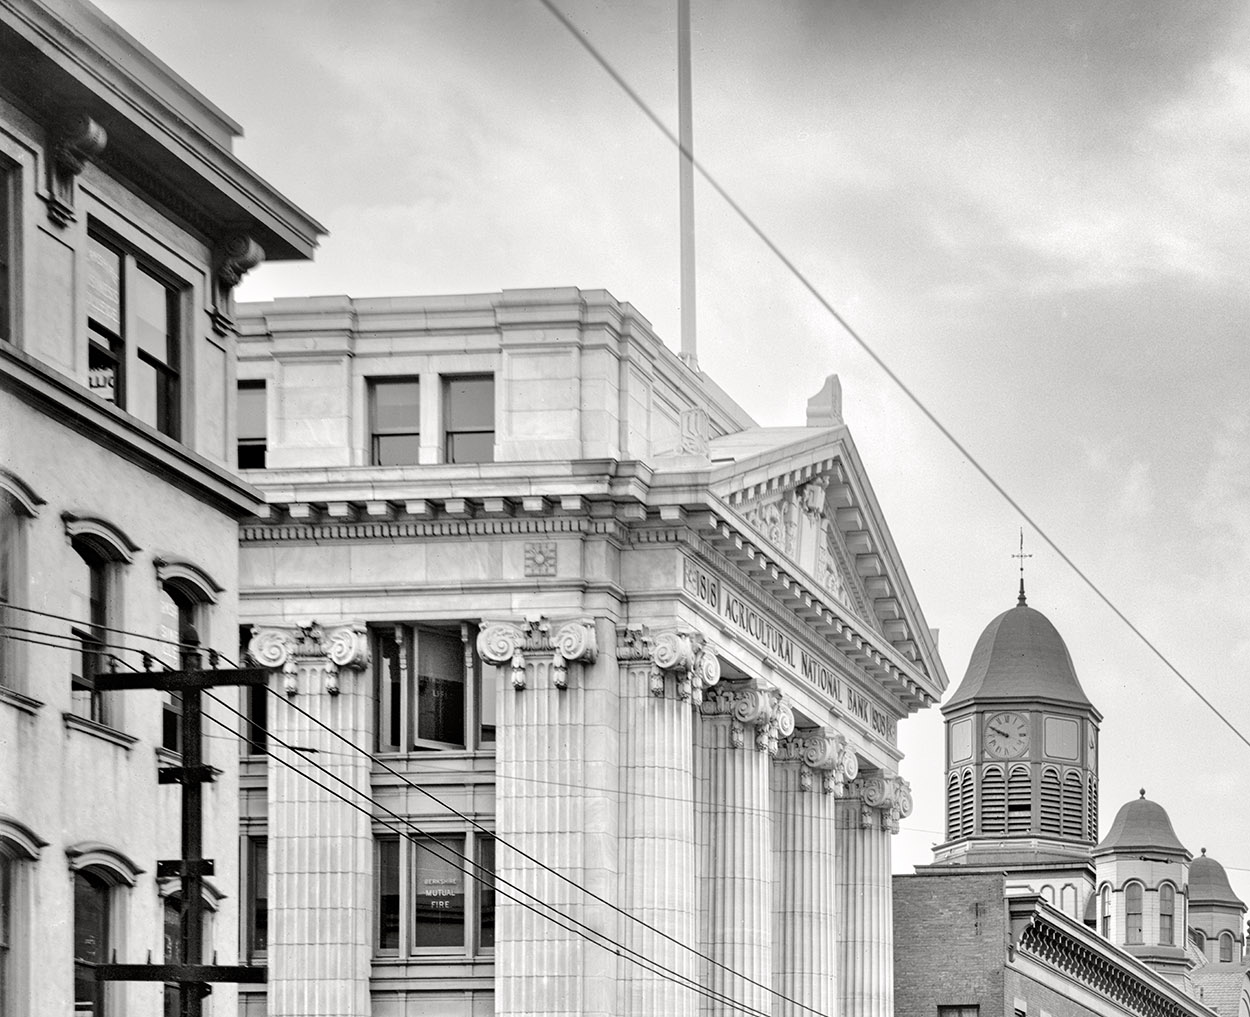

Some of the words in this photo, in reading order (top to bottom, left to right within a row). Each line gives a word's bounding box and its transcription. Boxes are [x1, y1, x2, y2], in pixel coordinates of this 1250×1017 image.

[725, 593, 796, 669] AGRICULTURAL
[801, 651, 843, 704] NATIONAL
[847, 687, 869, 724] BANK
[425, 889, 456, 897] MUTUAL
[431, 900, 450, 909] FIRE
